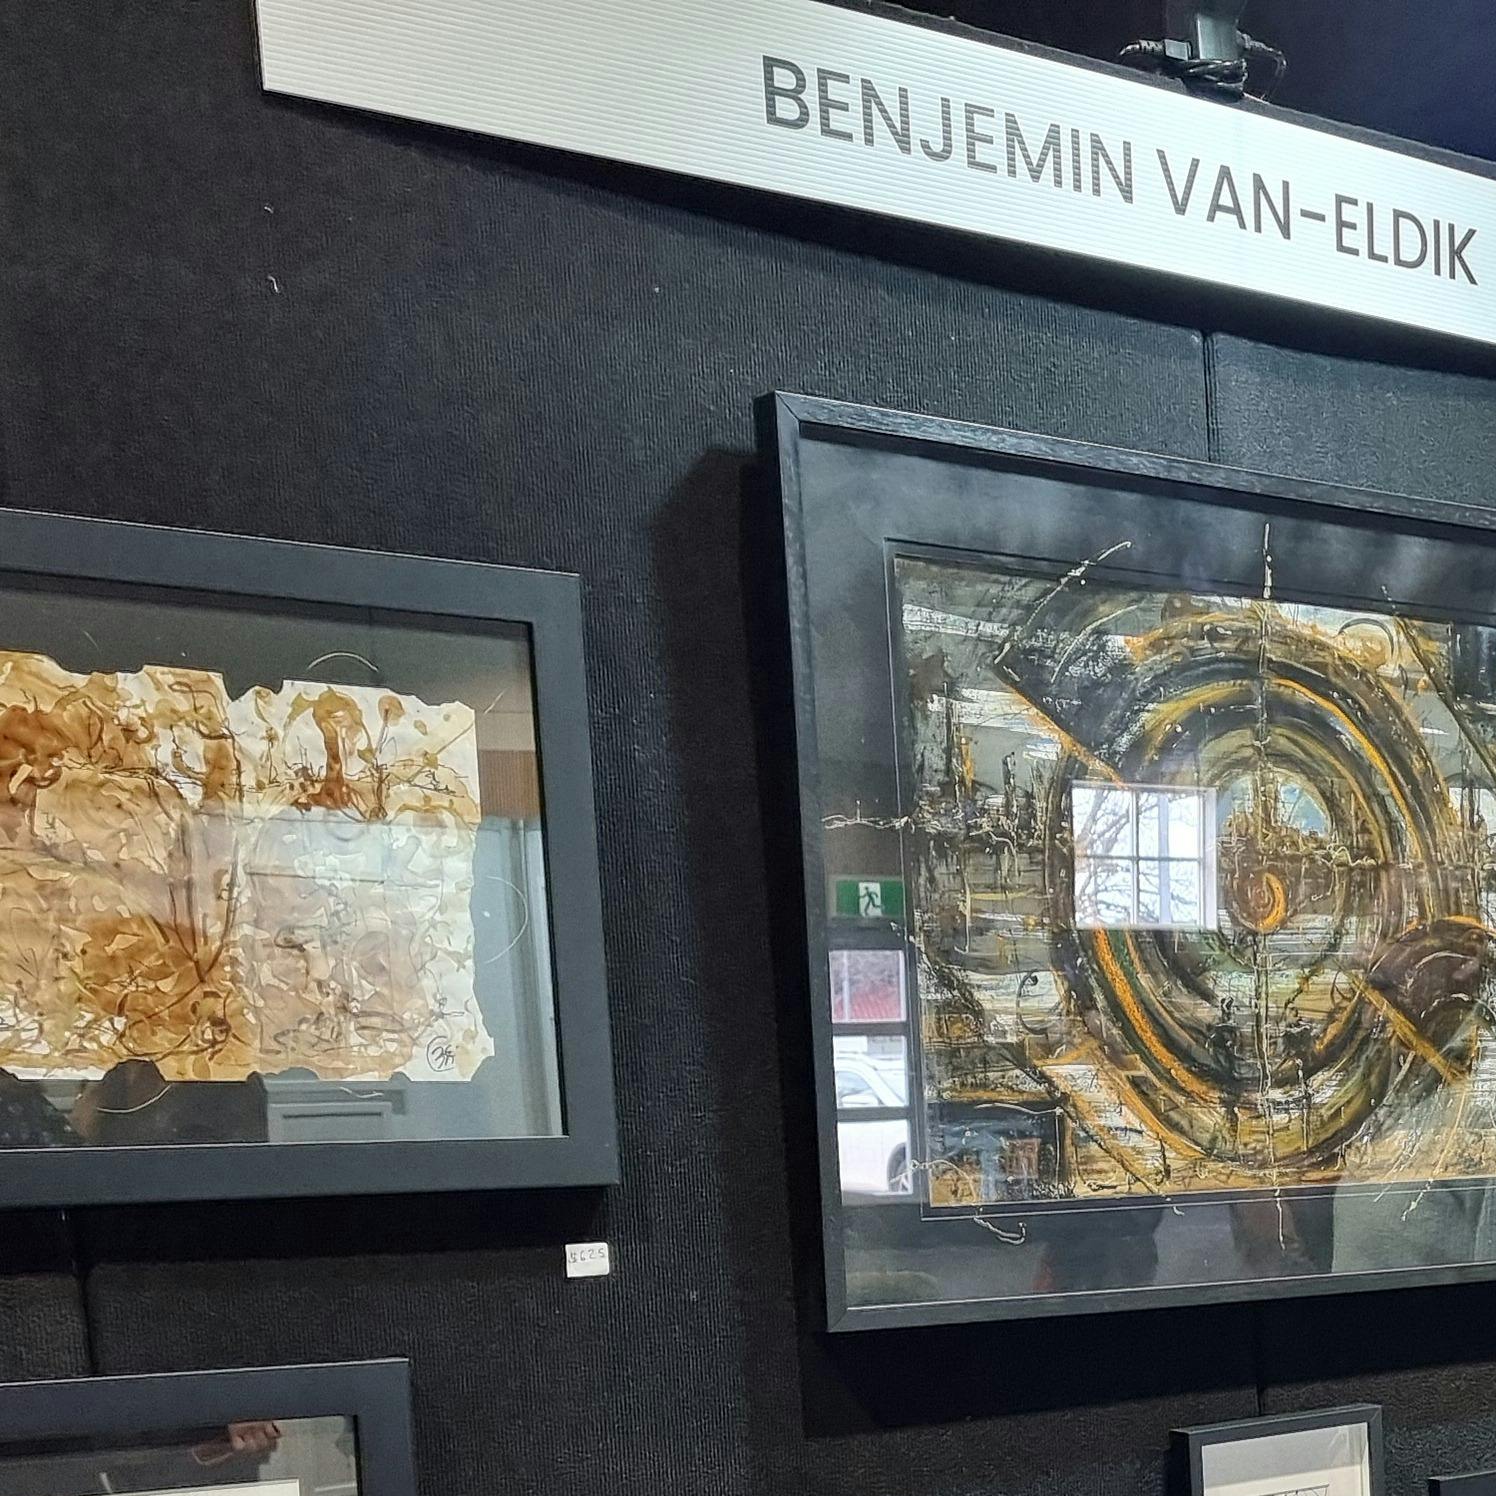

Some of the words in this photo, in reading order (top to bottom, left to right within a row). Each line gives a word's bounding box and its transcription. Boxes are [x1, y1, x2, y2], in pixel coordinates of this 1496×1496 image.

[762, 55, 1134, 204] BENJEMIN
[1157, 148, 1479, 286] VAN-ELDIK
[568, 1247, 605, 1264] $625
